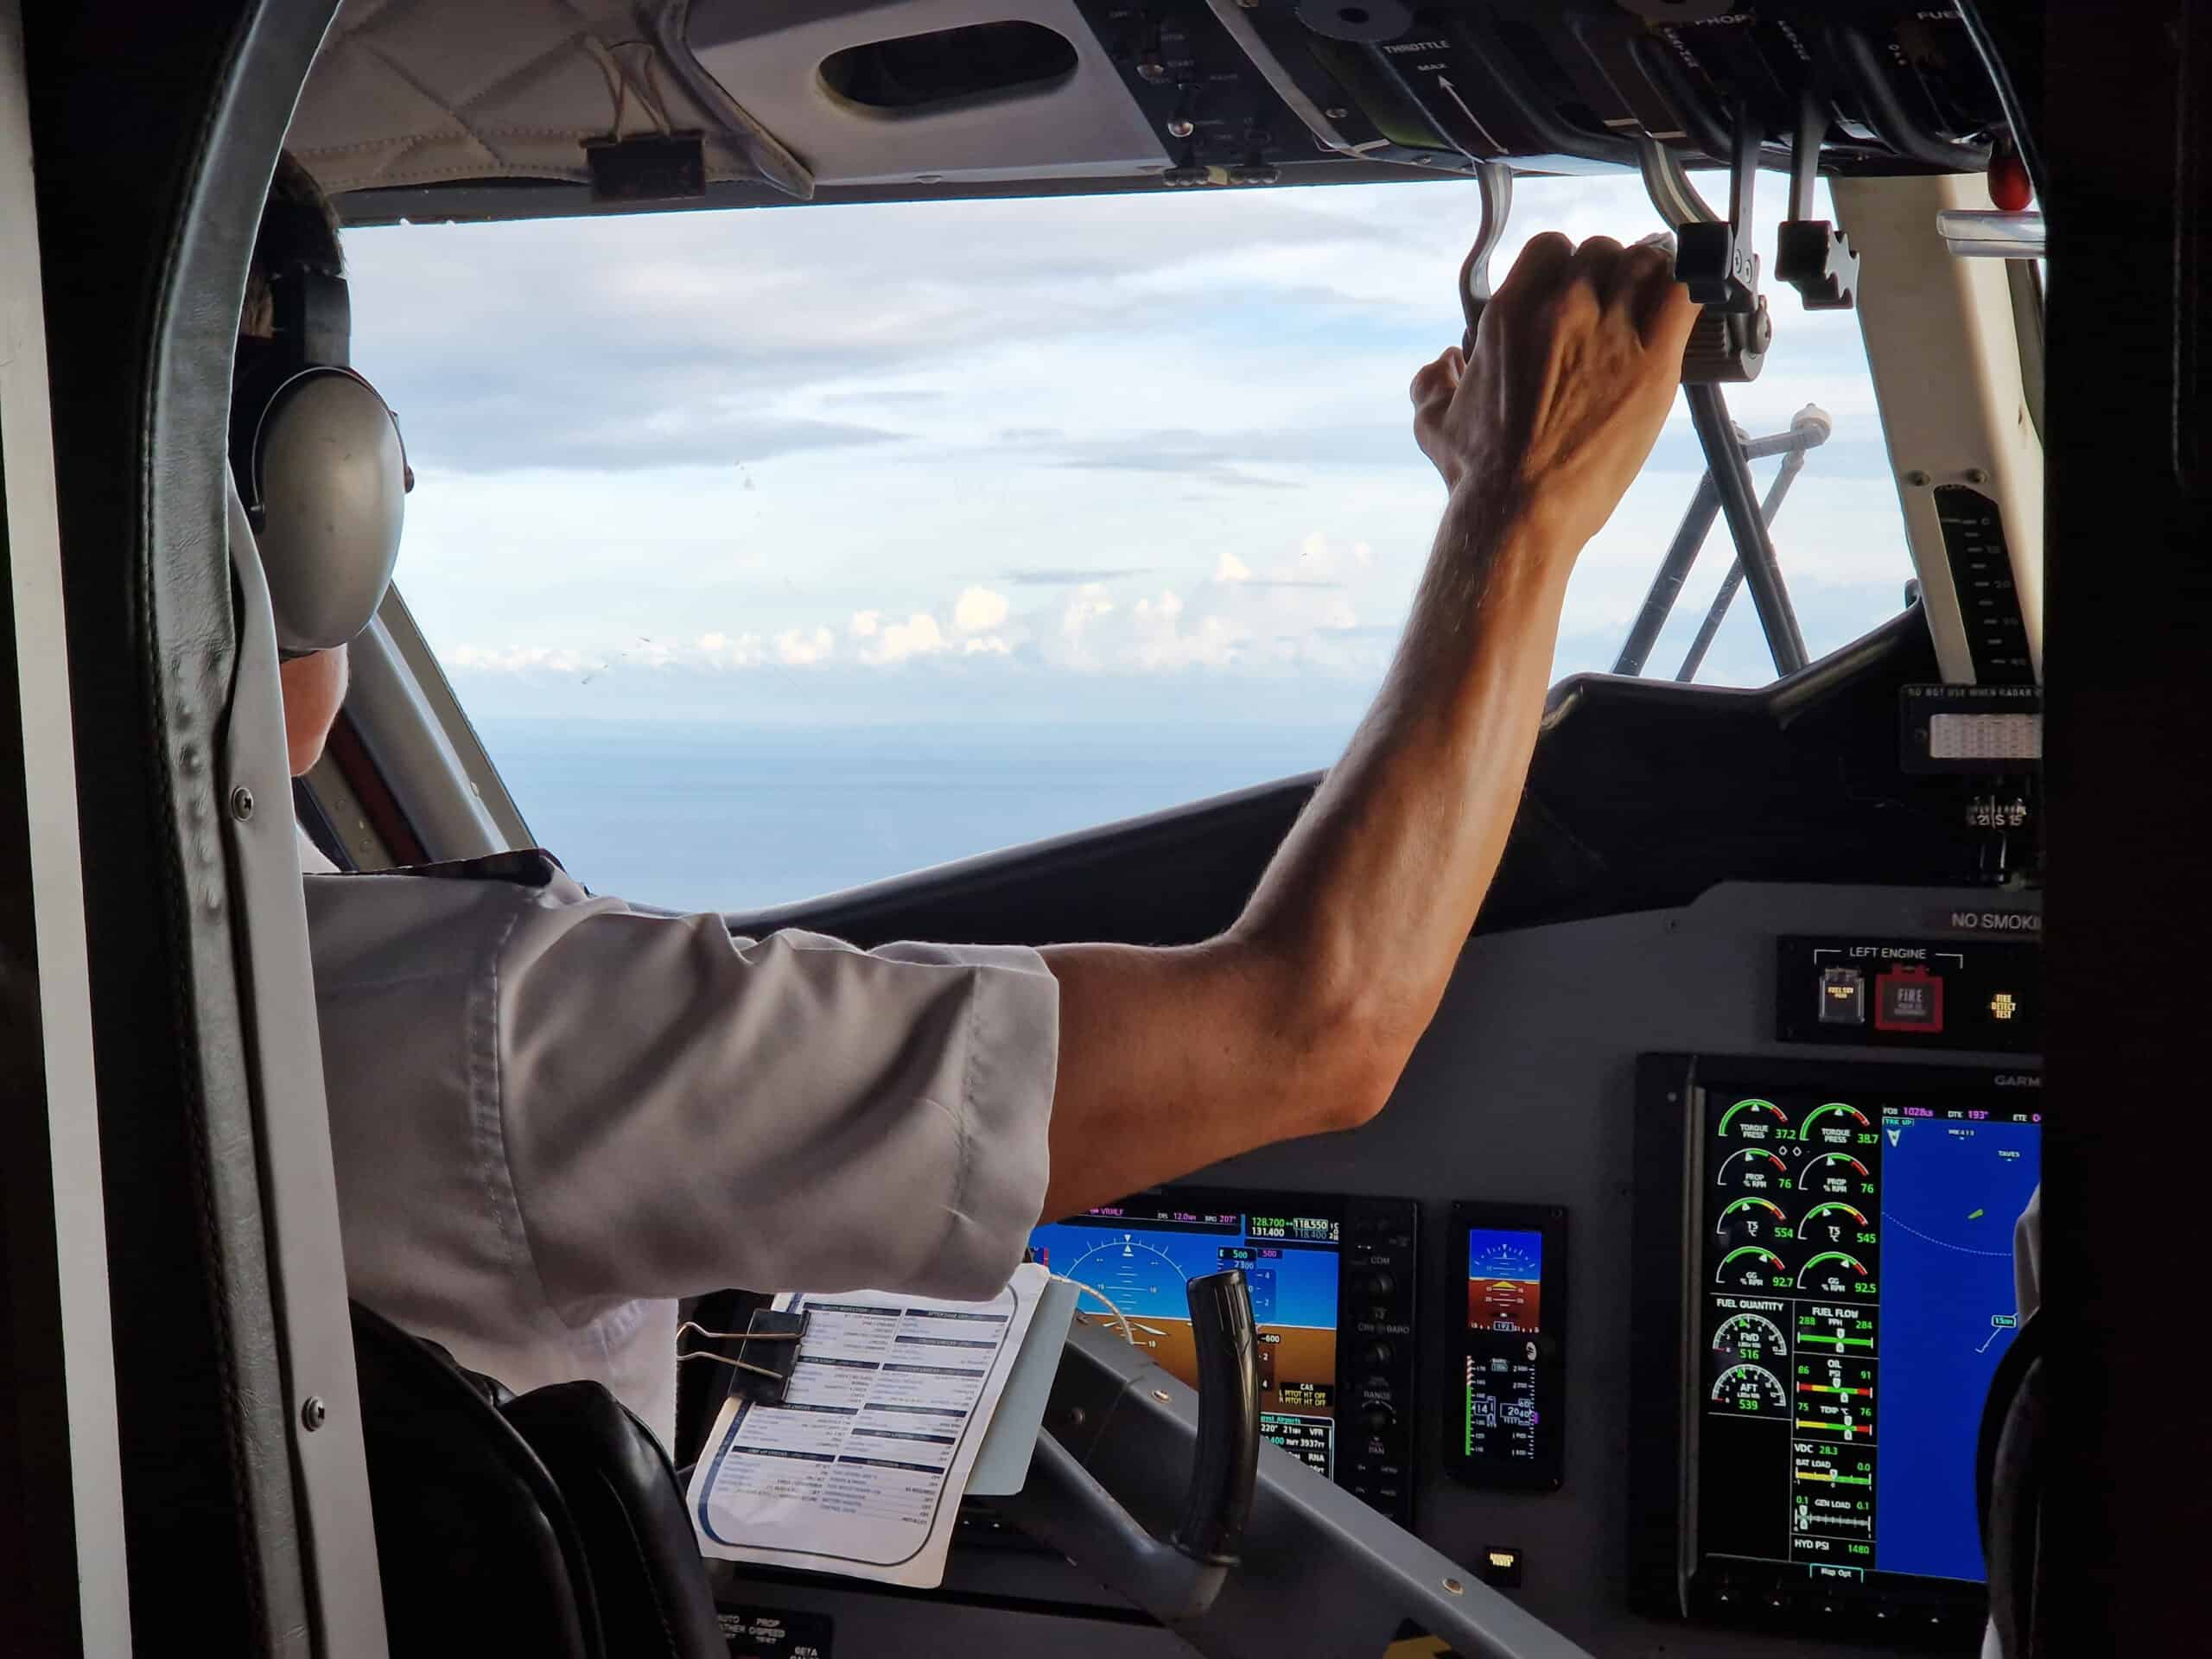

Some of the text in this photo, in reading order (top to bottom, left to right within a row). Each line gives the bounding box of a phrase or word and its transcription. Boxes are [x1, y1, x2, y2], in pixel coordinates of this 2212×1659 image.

[1382, 40, 1452, 54] THROTTLE
[1951, 913, 1977, 927] NO
[1849, 947, 1928, 960] LEFT ENGINE
[1897, 988, 1922, 1002] FIRE
[1991, 1002, 2016, 1012] DETECT
[1740, 1123, 1769, 1132] TORQUE
[1821, 1128, 1851, 1137] TORQUE
[1743, 1130, 1765, 1139] PRESS
[1775, 1129, 1796, 1140] 37.2
[1825, 1135, 1847, 1143] PRESS
[1857, 1134, 1879, 1144] 38.7
[1751, 1180, 1767, 1189] RPM
[1778, 1179, 1792, 1188] 76
[1860, 1183, 1874, 1193] 76
[1831, 1185, 1847, 1193] RPM
[1252, 1217, 1327, 1230] 128.700 118.550
[1252, 1227, 1285, 1236] 131.400
[1775, 1227, 1793, 1237] 554
[1857, 1233, 1877, 1243] 545
[1232, 1249, 1248, 1259] 500
[1748, 1278, 1764, 1287] RPM
[1772, 1276, 1793, 1287] 92.7
[1829, 1283, 1846, 1292] RPM
[1855, 1282, 1877, 1293] 92.5
[1716, 1298, 1783, 1312] FUEL QUANTITY
[1812, 1306, 1859, 1319] FUEL FLOW
[1855, 1320, 1872, 1330] 284
[1740, 1332, 1759, 1342] FWD
[1739, 1349, 1759, 1359] 516
[1827, 1359, 1842, 1369] OIL
[1860, 1370, 1872, 1380] 91
[1740, 1383, 1758, 1392] AFT
[1738, 1399, 1758, 1410] 539
[1798, 1402, 1809, 1411] 75
[1859, 1407, 1872, 1417] 76
[1794, 1443, 1814, 1453] VDC
[1796, 1459, 1831, 1468] BAT LOAD
[1857, 1462, 1871, 1471] 0.0
[1796, 1495, 1809, 1505] 0.1
[1831, 1500, 1851, 1510] LOAD
[1856, 1501, 1869, 1510] 0.1
[1794, 1539, 1830, 1551] HYD PSI
[756, 1618, 780, 1627] PROP
[795, 1646, 817, 1656] BETA
